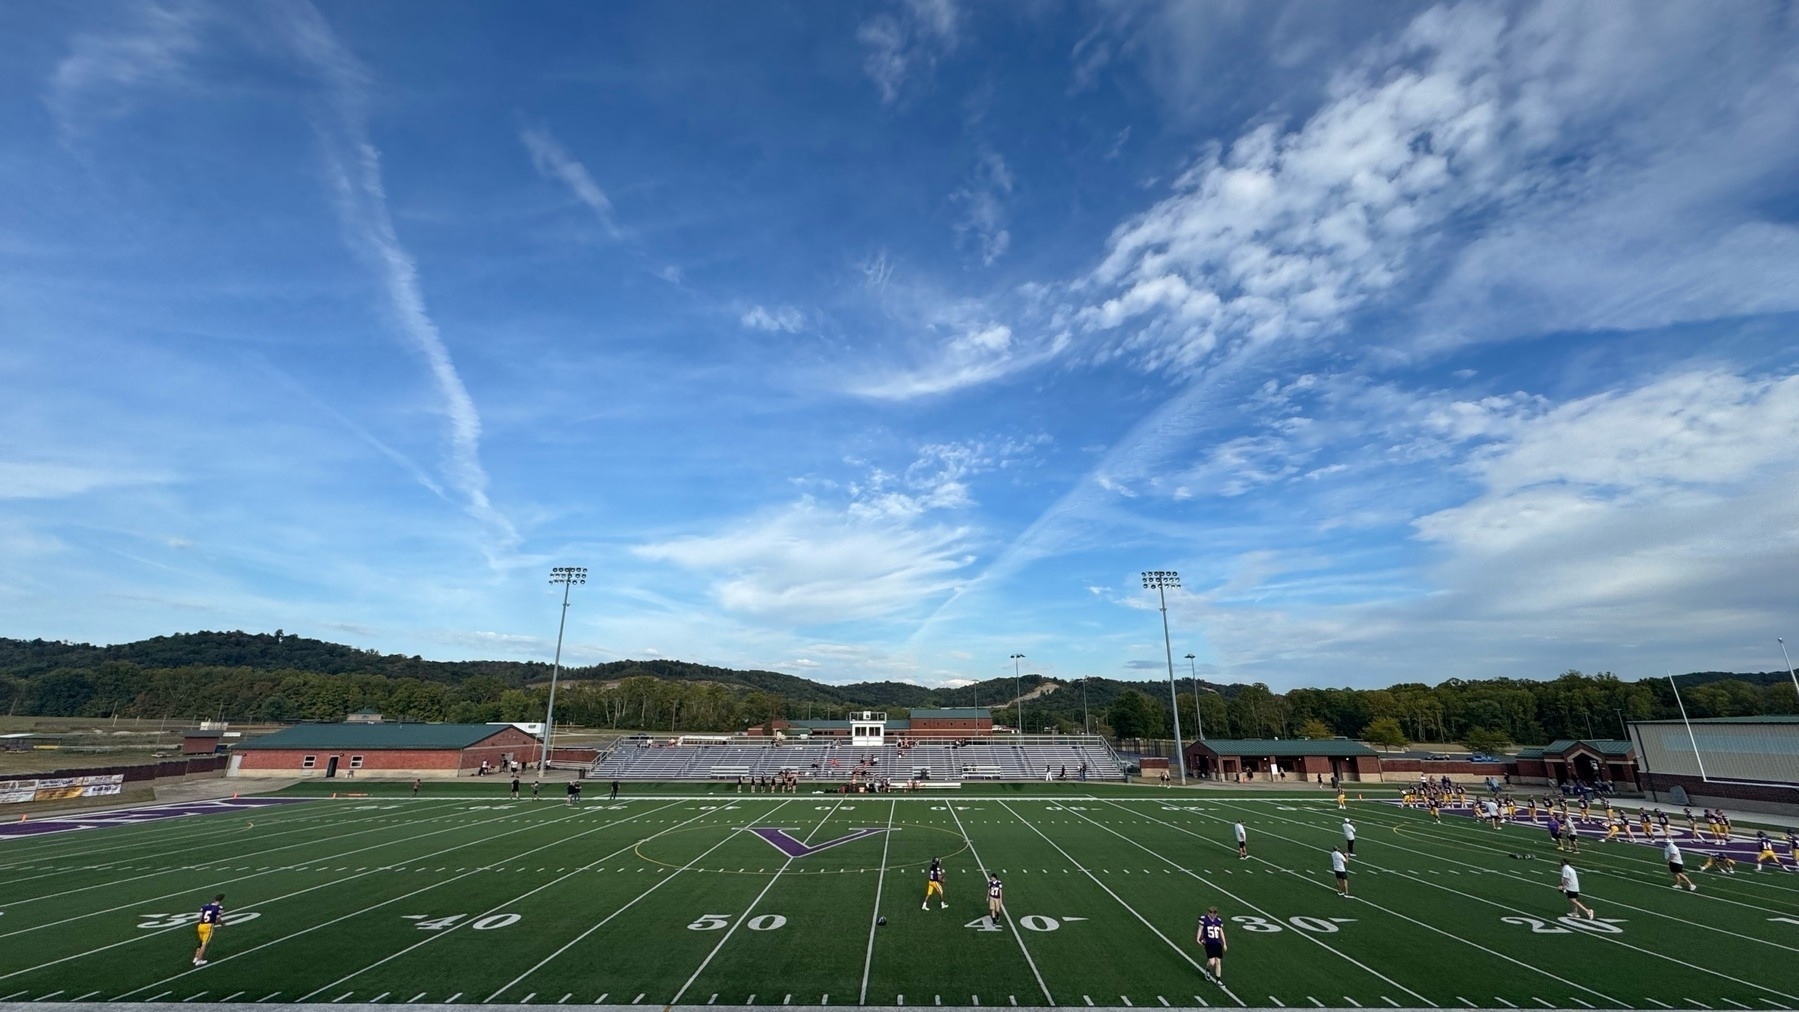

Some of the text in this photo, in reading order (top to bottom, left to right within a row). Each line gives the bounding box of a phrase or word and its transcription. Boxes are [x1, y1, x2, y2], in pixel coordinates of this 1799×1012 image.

[731, 827, 902, 858] V
[203, 910, 213, 923] 5
[414, 913, 522, 930] 40
[686, 914, 788, 931] 50
[963, 914, 1060, 932] 40
[1230, 915, 1340, 933] 30
[1500, 916, 1624, 934] 20
